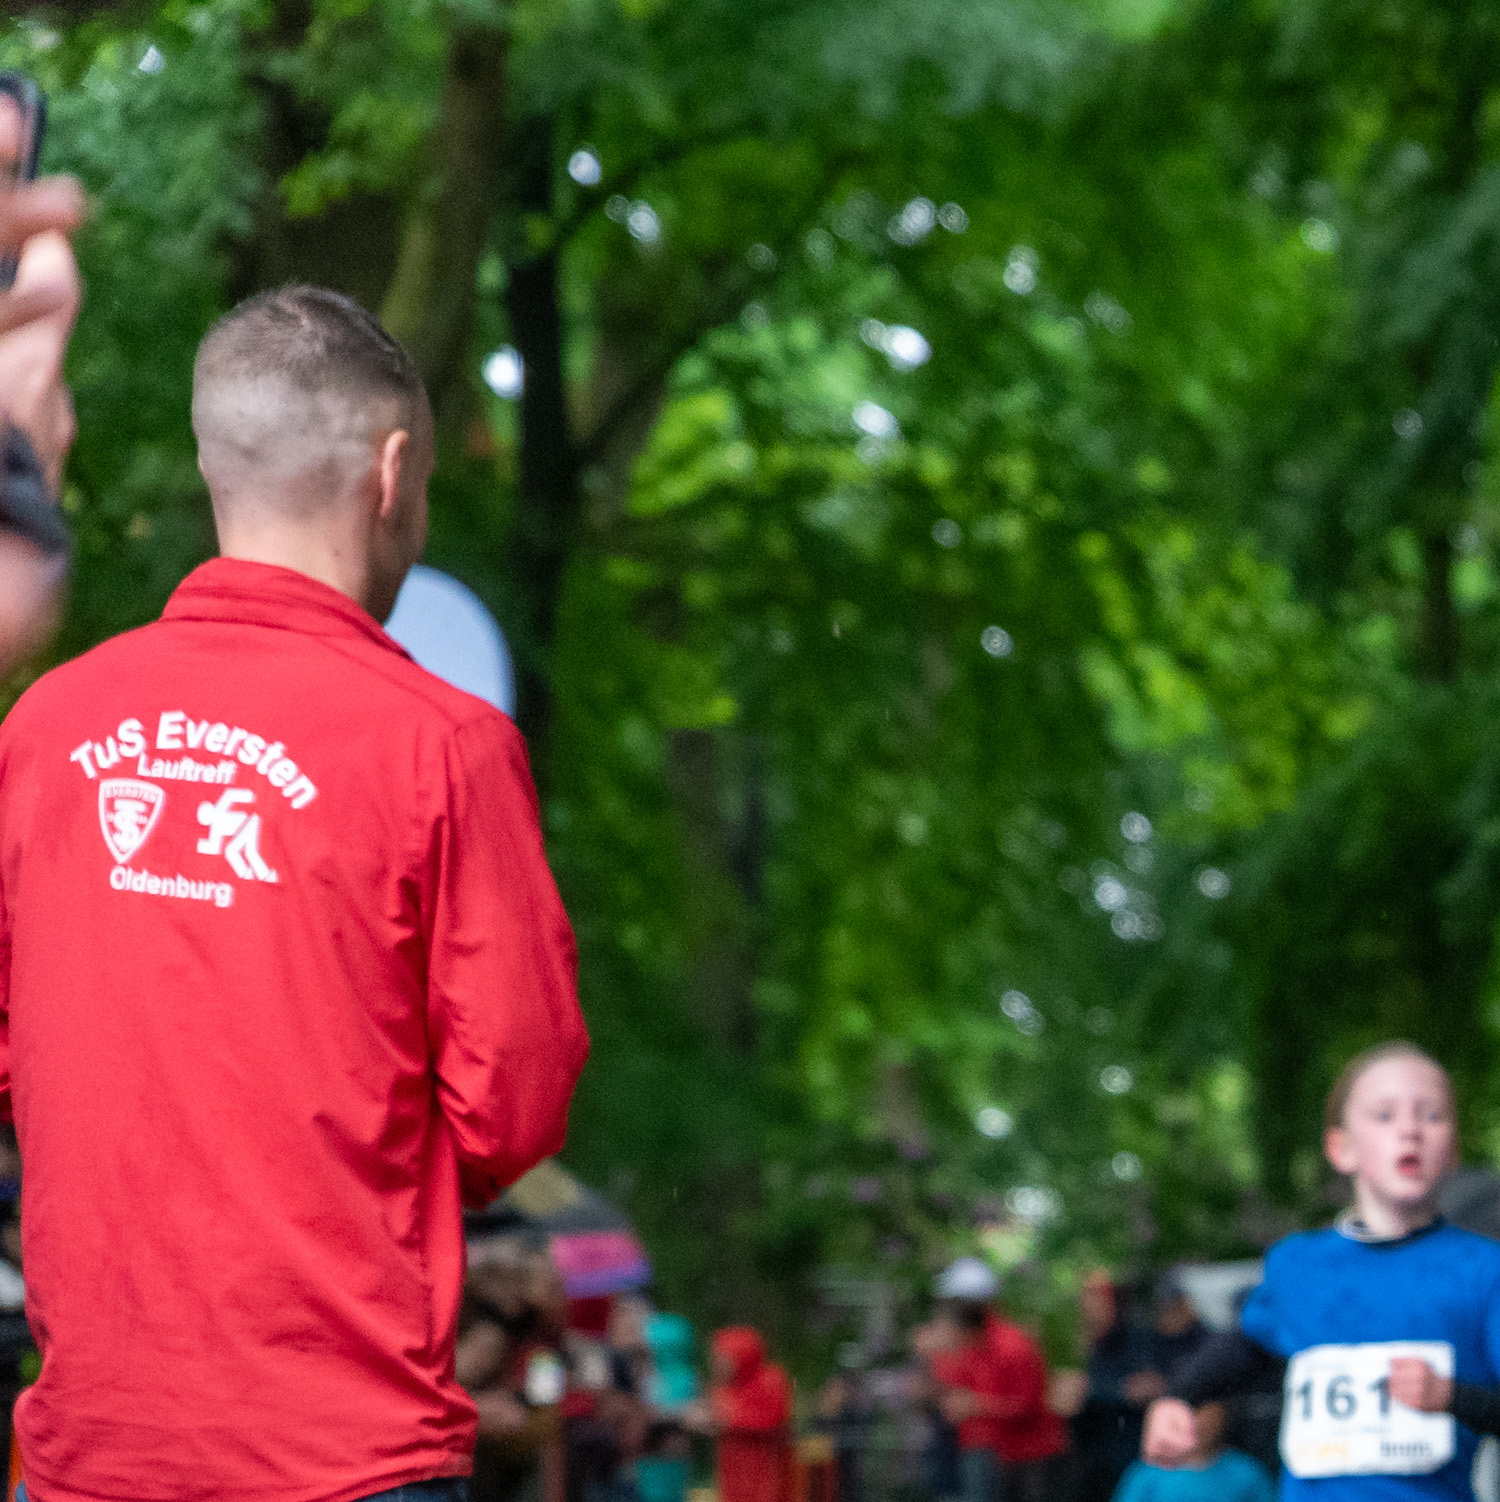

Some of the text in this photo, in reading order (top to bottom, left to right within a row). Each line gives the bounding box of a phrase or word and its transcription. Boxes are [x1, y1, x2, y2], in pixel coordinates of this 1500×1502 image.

[69, 710, 317, 809] TuS Eversten
[136, 753, 238, 784] Lauftreff
[109, 866, 233, 908] Oldenburg
[1296, 1373, 1392, 1421] 161
